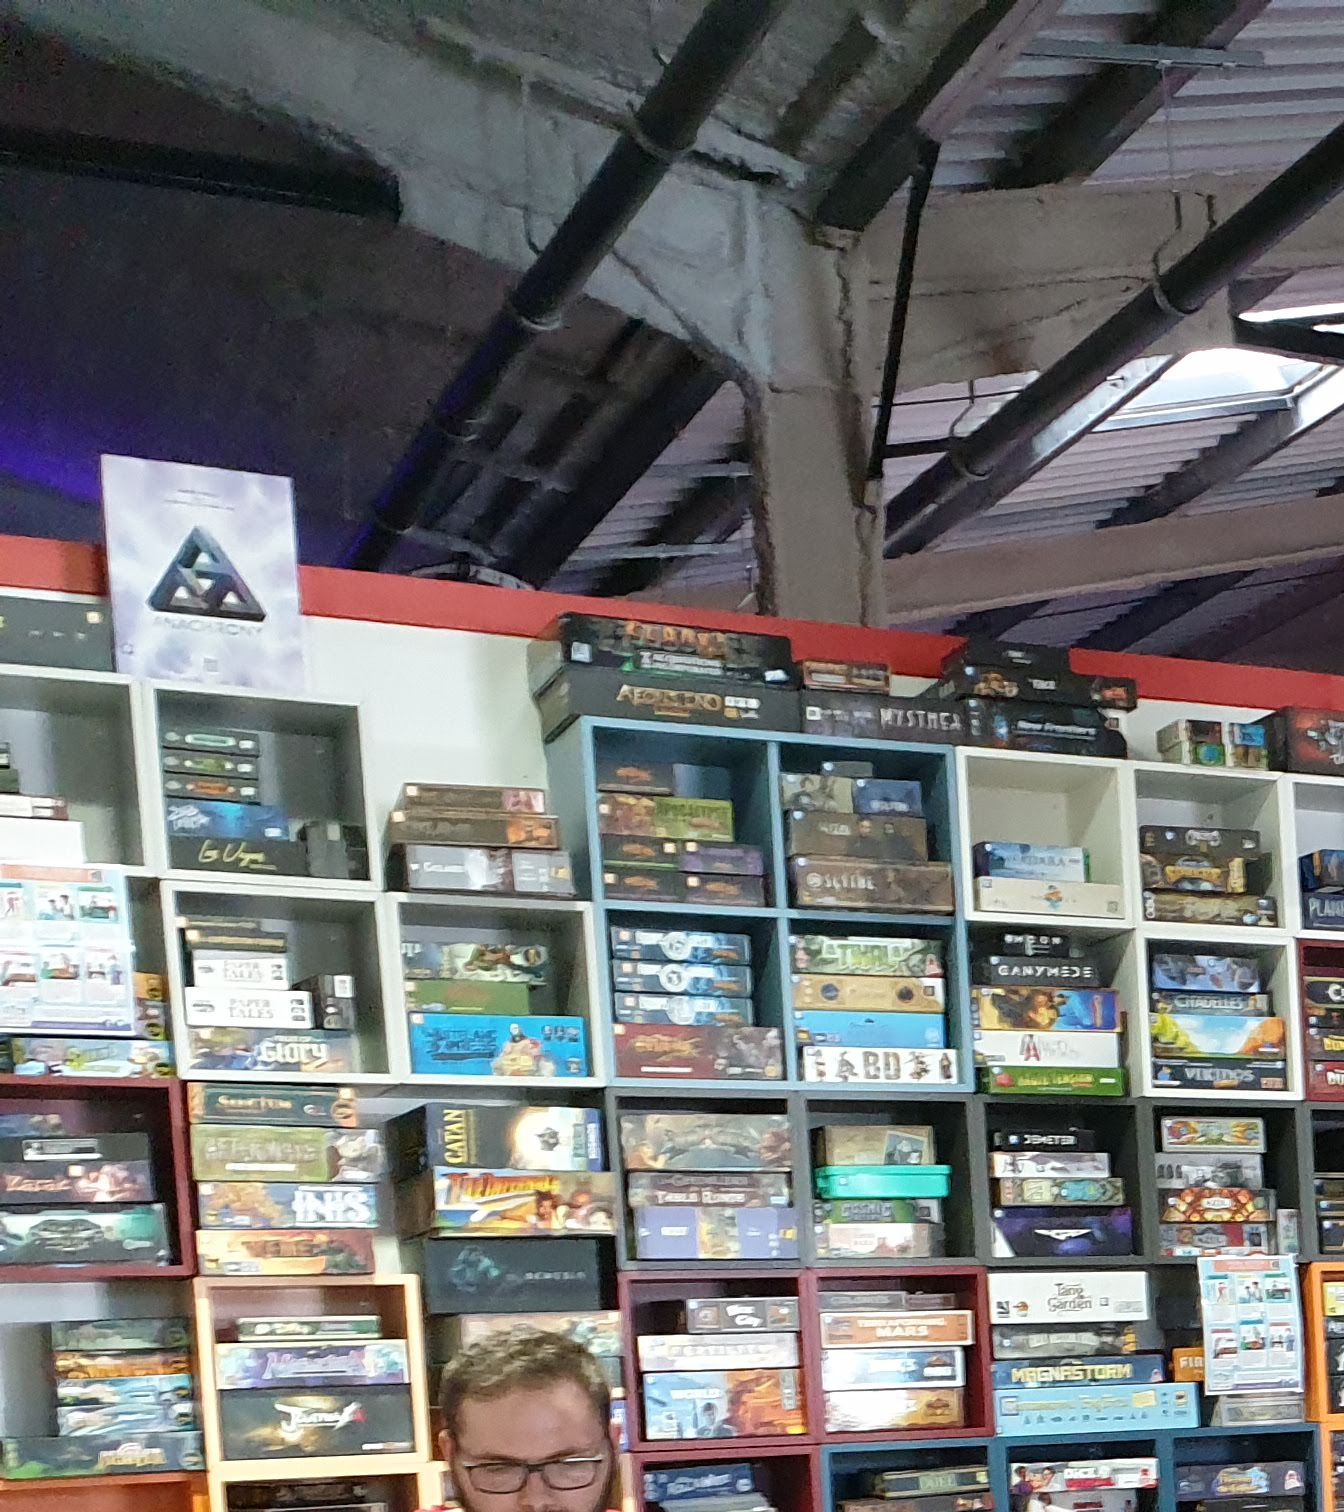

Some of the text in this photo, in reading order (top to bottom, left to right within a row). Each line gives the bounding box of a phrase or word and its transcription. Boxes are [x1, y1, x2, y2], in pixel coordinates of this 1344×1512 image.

[997, 964, 1095, 979] GANYMEDE
[443, 1108, 469, 1165] CATAN
[1047, 1296, 1093, 1312] Garden
[875, 1325, 929, 1338] MARS
[1011, 1362, 1133, 1384] MAGNASTORM
